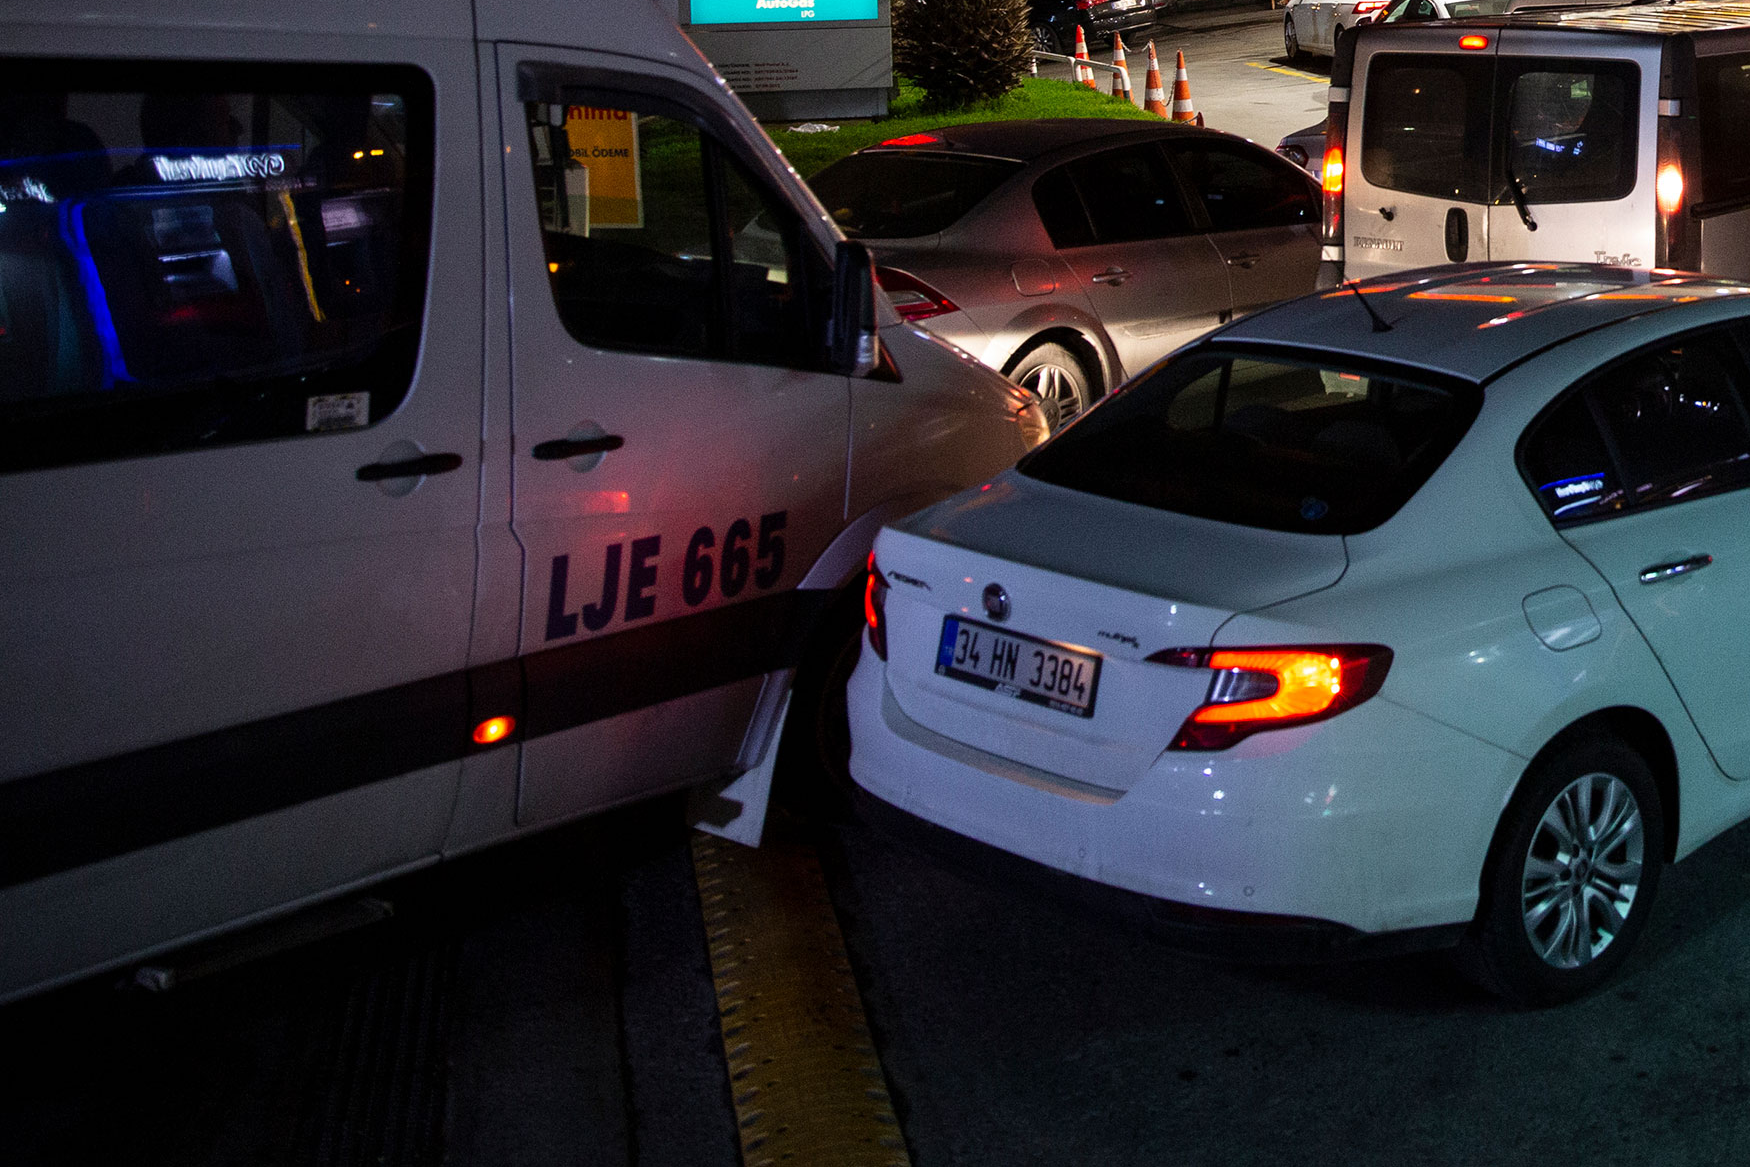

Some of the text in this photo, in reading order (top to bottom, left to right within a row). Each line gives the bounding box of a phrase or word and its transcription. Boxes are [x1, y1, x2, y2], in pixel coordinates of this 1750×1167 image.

[801, 10, 815, 18] LPG
[591, 146, 630, 158] ÖDEME
[545, 509, 788, 641] LJE 665
[955, 628, 1086, 701] 34 HN 3384
